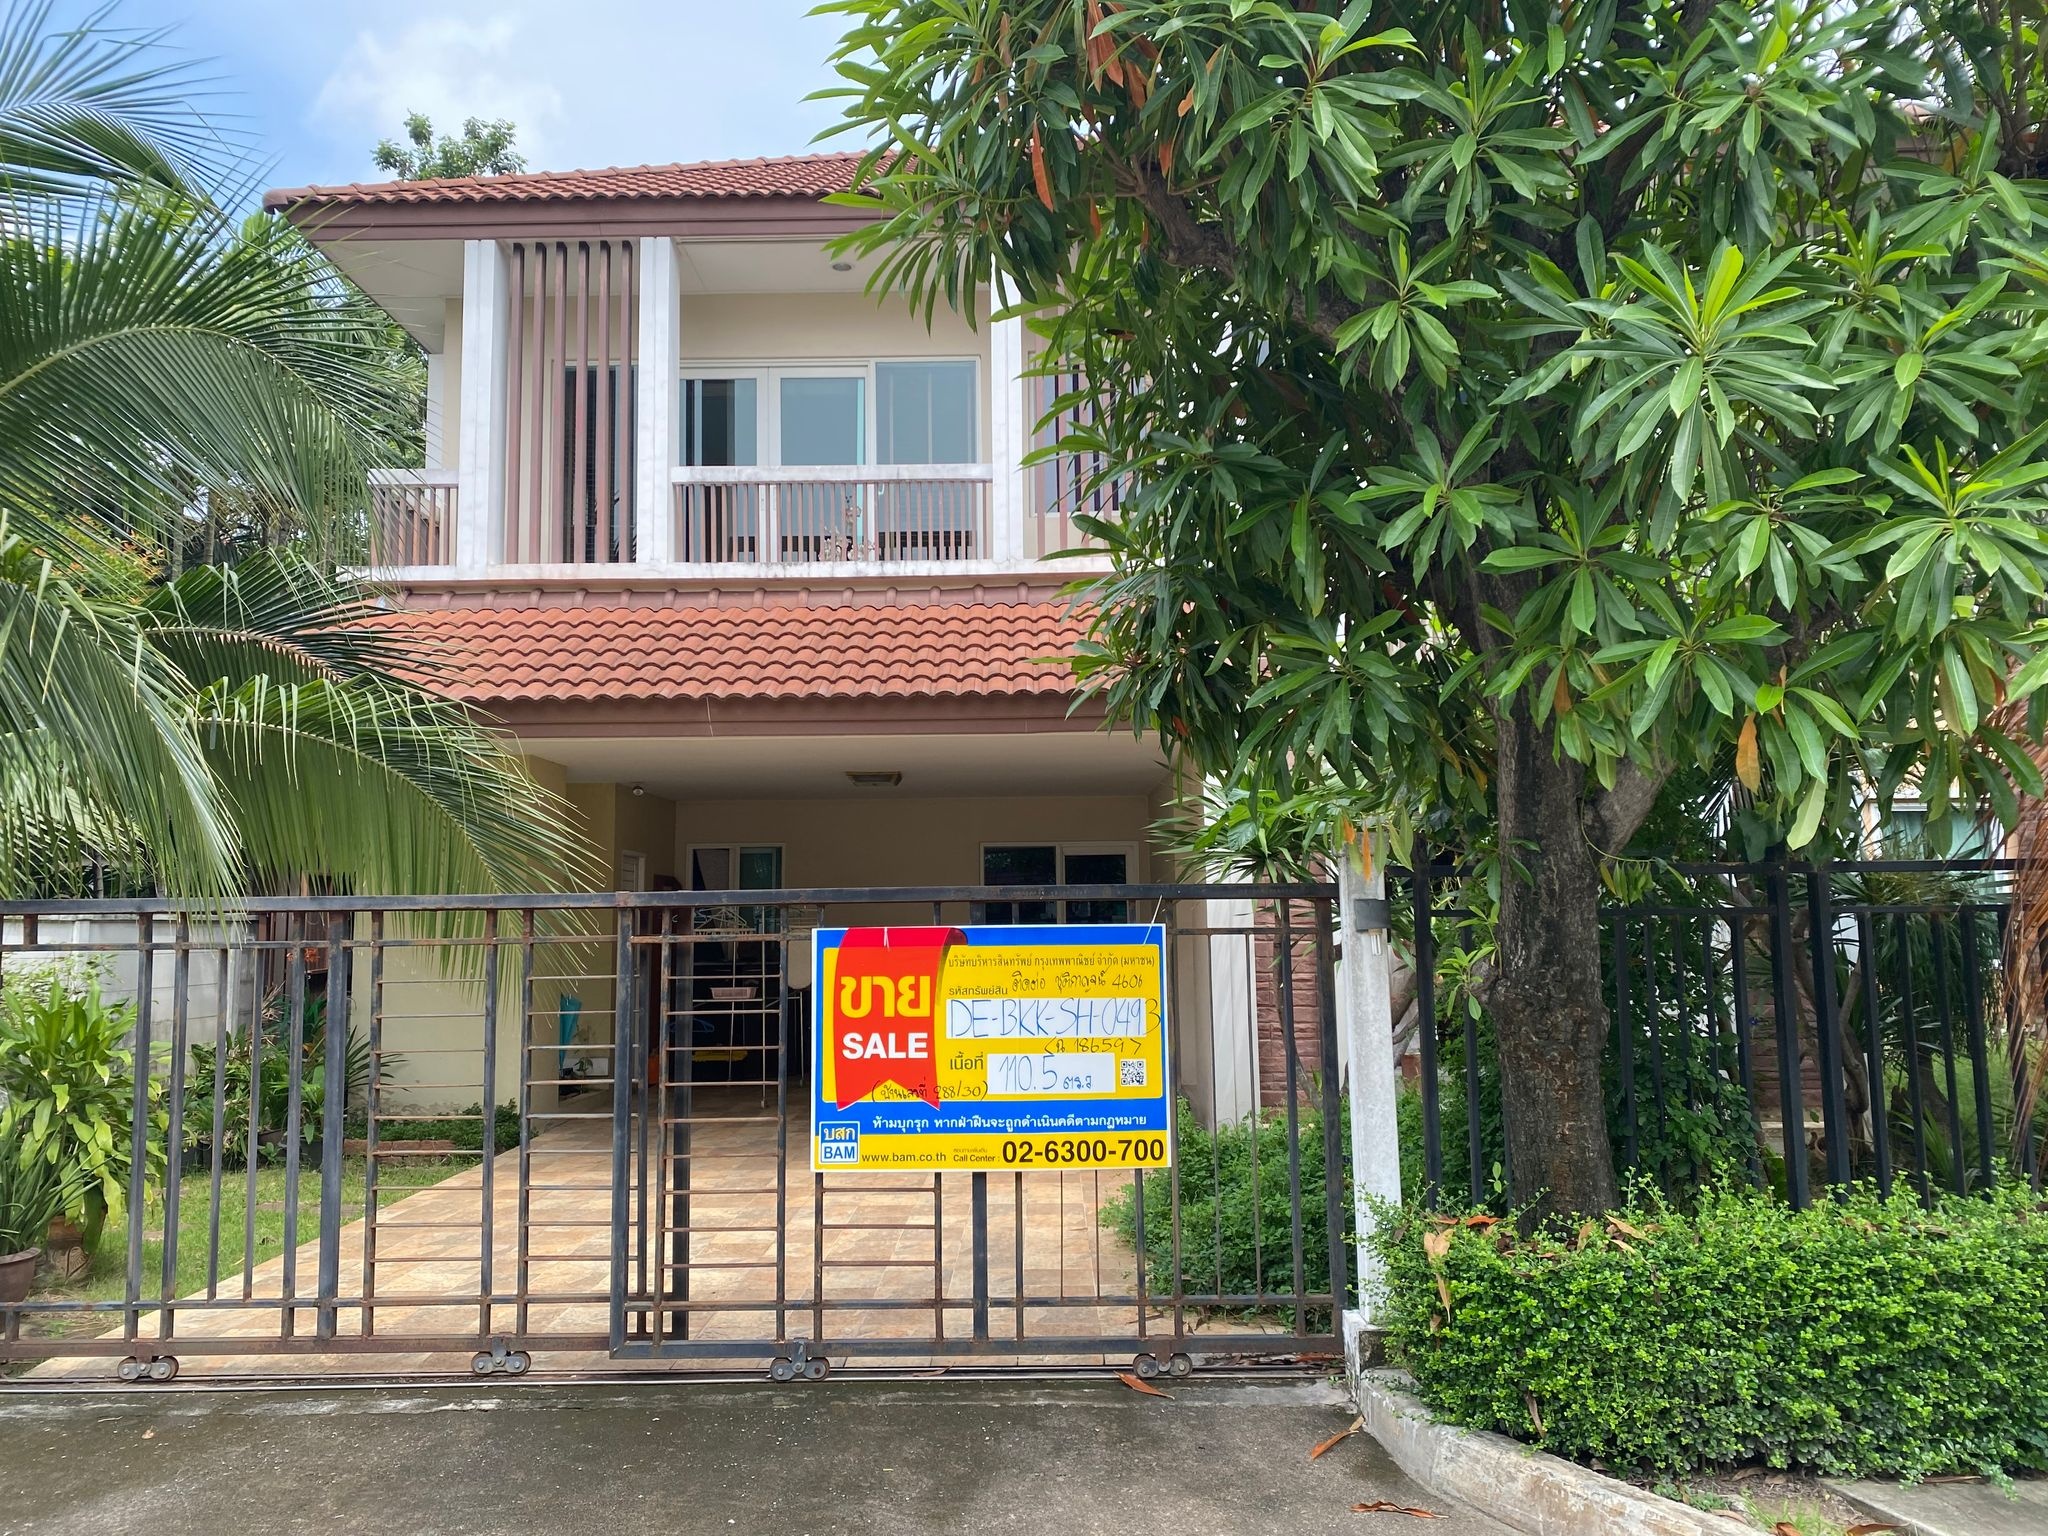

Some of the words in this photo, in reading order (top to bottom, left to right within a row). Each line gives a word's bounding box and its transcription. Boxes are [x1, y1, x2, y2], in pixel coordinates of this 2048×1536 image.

[1034, 953, 1095, 971] กรุงเทพพาณิชย์
[1097, 953, 1119, 966] จำกัด
[1121, 955, 1155, 968] (มหาชน)
[840, 975, 931, 1018] ขาย
[949, 985, 1008, 996] รหัสทรัพย์สิน
[951, 998, 1161, 1037] DE-BKK-SH-0493
[842, 1032, 928, 1060] SALE
[950, 1051, 984, 1070] เนื้อที่
[872, 1115, 929, 1133] ห้ามบุกรุก
[934, 1114, 1147, 1133] หากฝ่าฝืนจะถูกดำเนินคดีตามกฎหมาย
[823, 1127, 856, 1141] บสก
[823, 1146, 855, 1160] BAM
[862, 1152, 947, 1162] www.bam.co.th
[953, 1154, 968, 1162] Call
[1002, 1138, 1164, 1163] 02-6300-700
